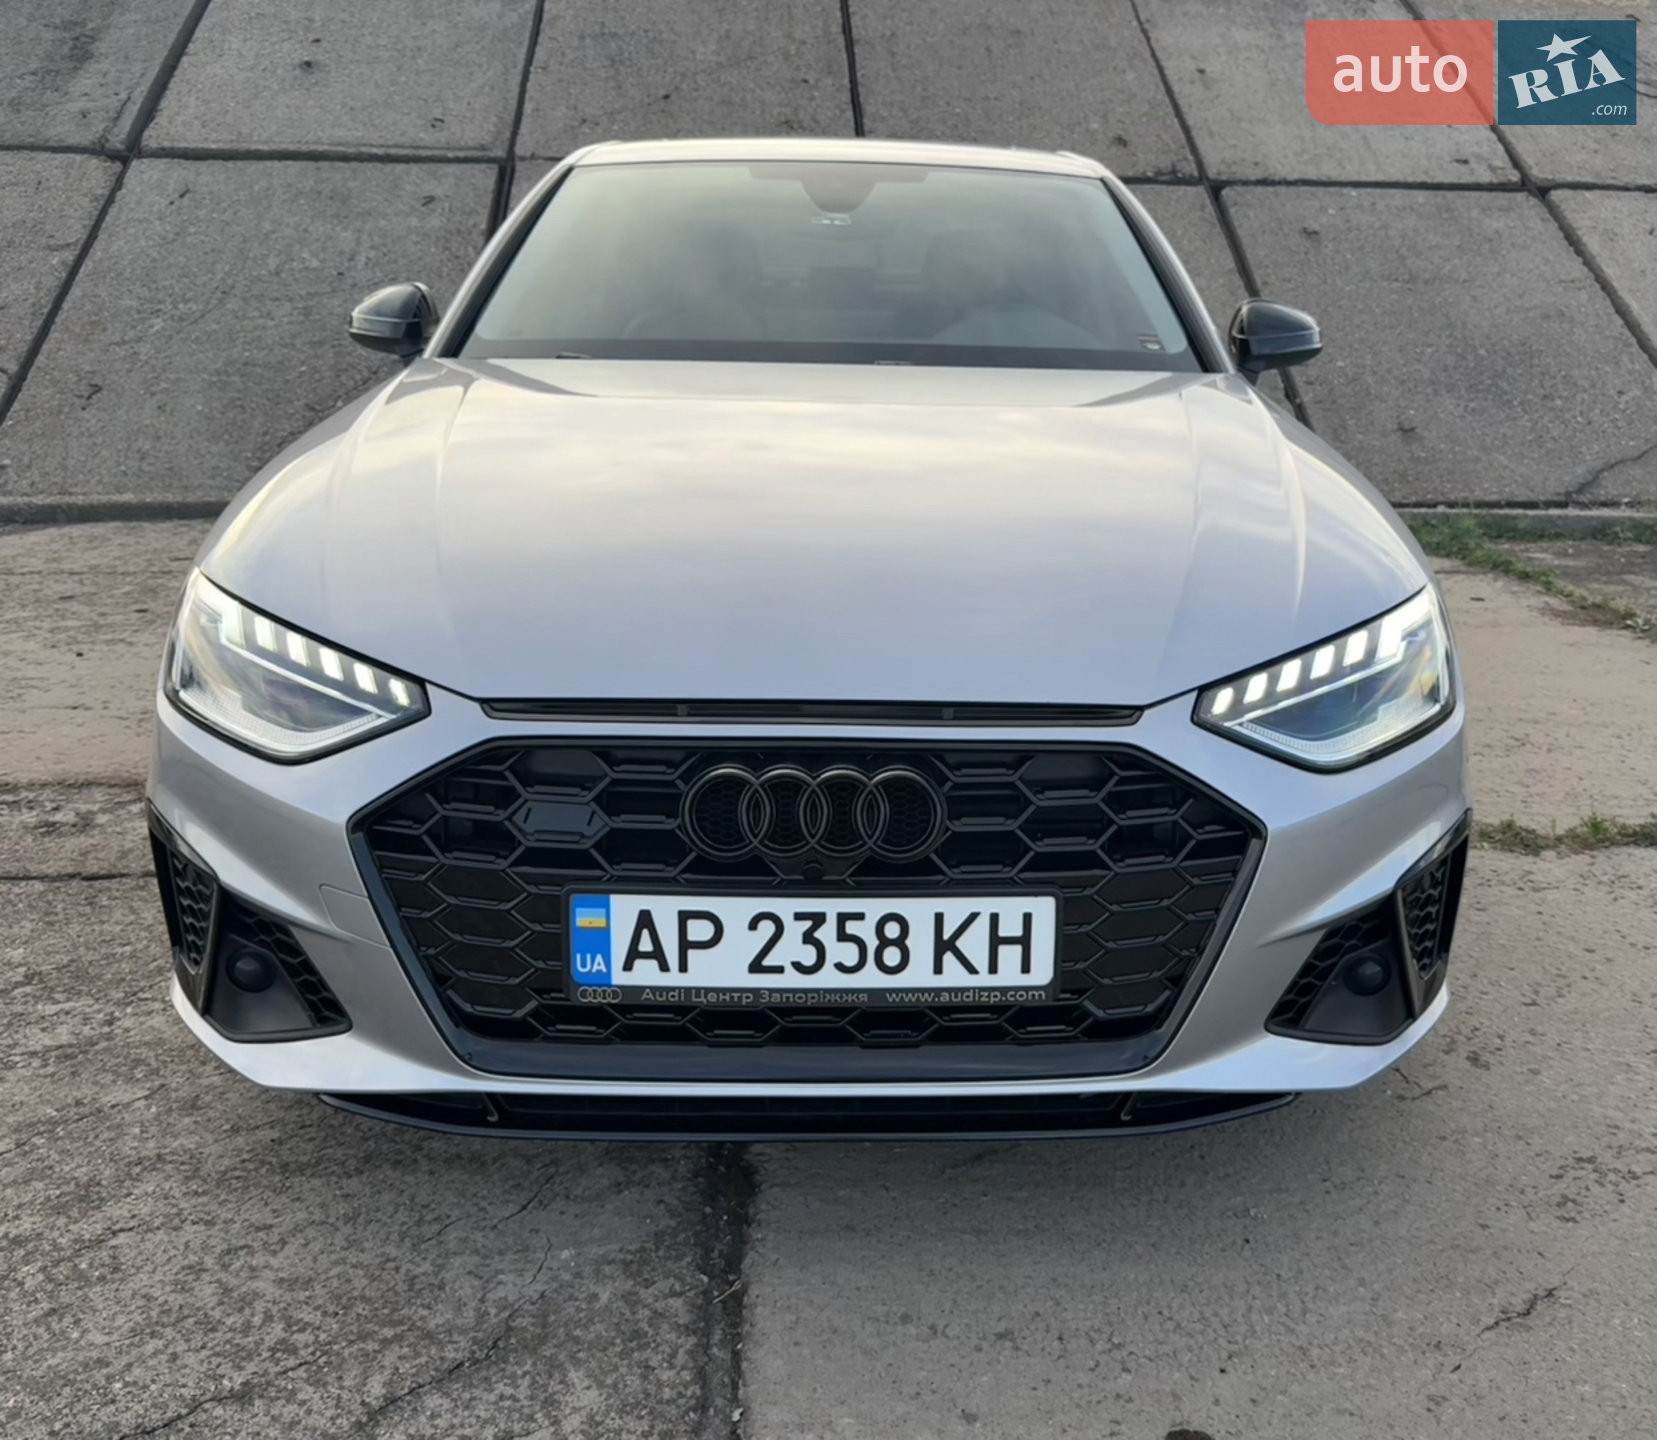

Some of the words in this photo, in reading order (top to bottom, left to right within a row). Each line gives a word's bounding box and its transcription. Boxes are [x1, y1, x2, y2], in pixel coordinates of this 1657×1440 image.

[621, 909, 724, 973] AP
[747, 911, 910, 975] 2358
[932, 911, 1033, 975] KH
[576, 953, 607, 974] UA
[640, 988, 685, 1002] Audi
[691, 988, 754, 1006] Центр
[886, 988, 1047, 1004] www.audizp.com
